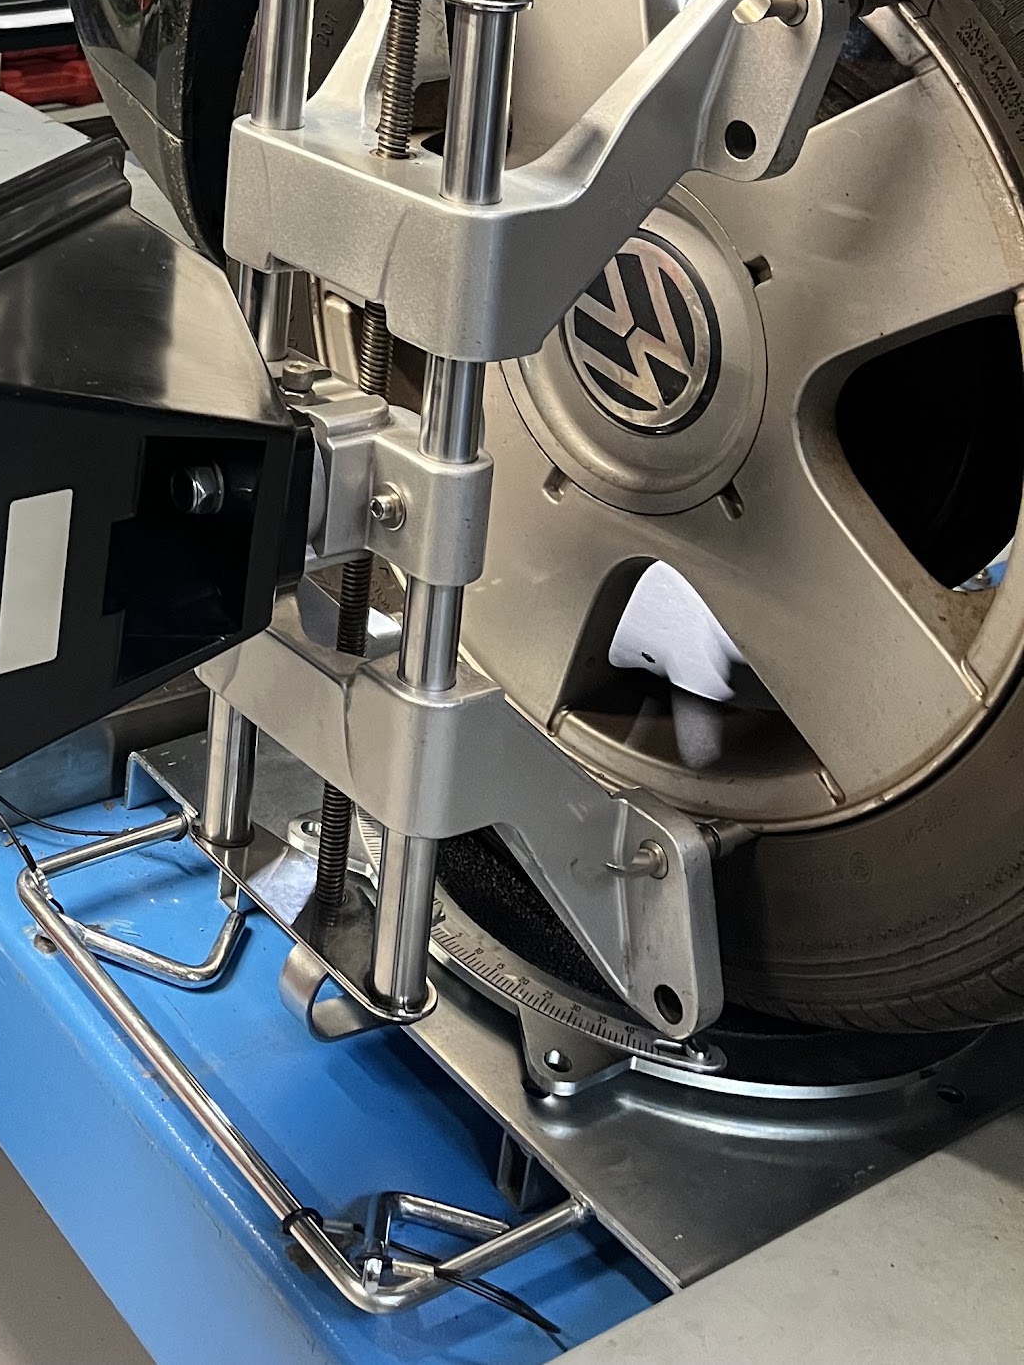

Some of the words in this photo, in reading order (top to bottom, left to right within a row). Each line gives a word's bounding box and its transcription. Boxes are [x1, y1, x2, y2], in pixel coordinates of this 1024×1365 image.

[316, 10, 339, 48] DOT
[518, 976, 530, 985] 20
[542, 990, 554, 999] 25
[570, 1002, 582, 1012] 30
[596, 1015, 607, 1024] 35
